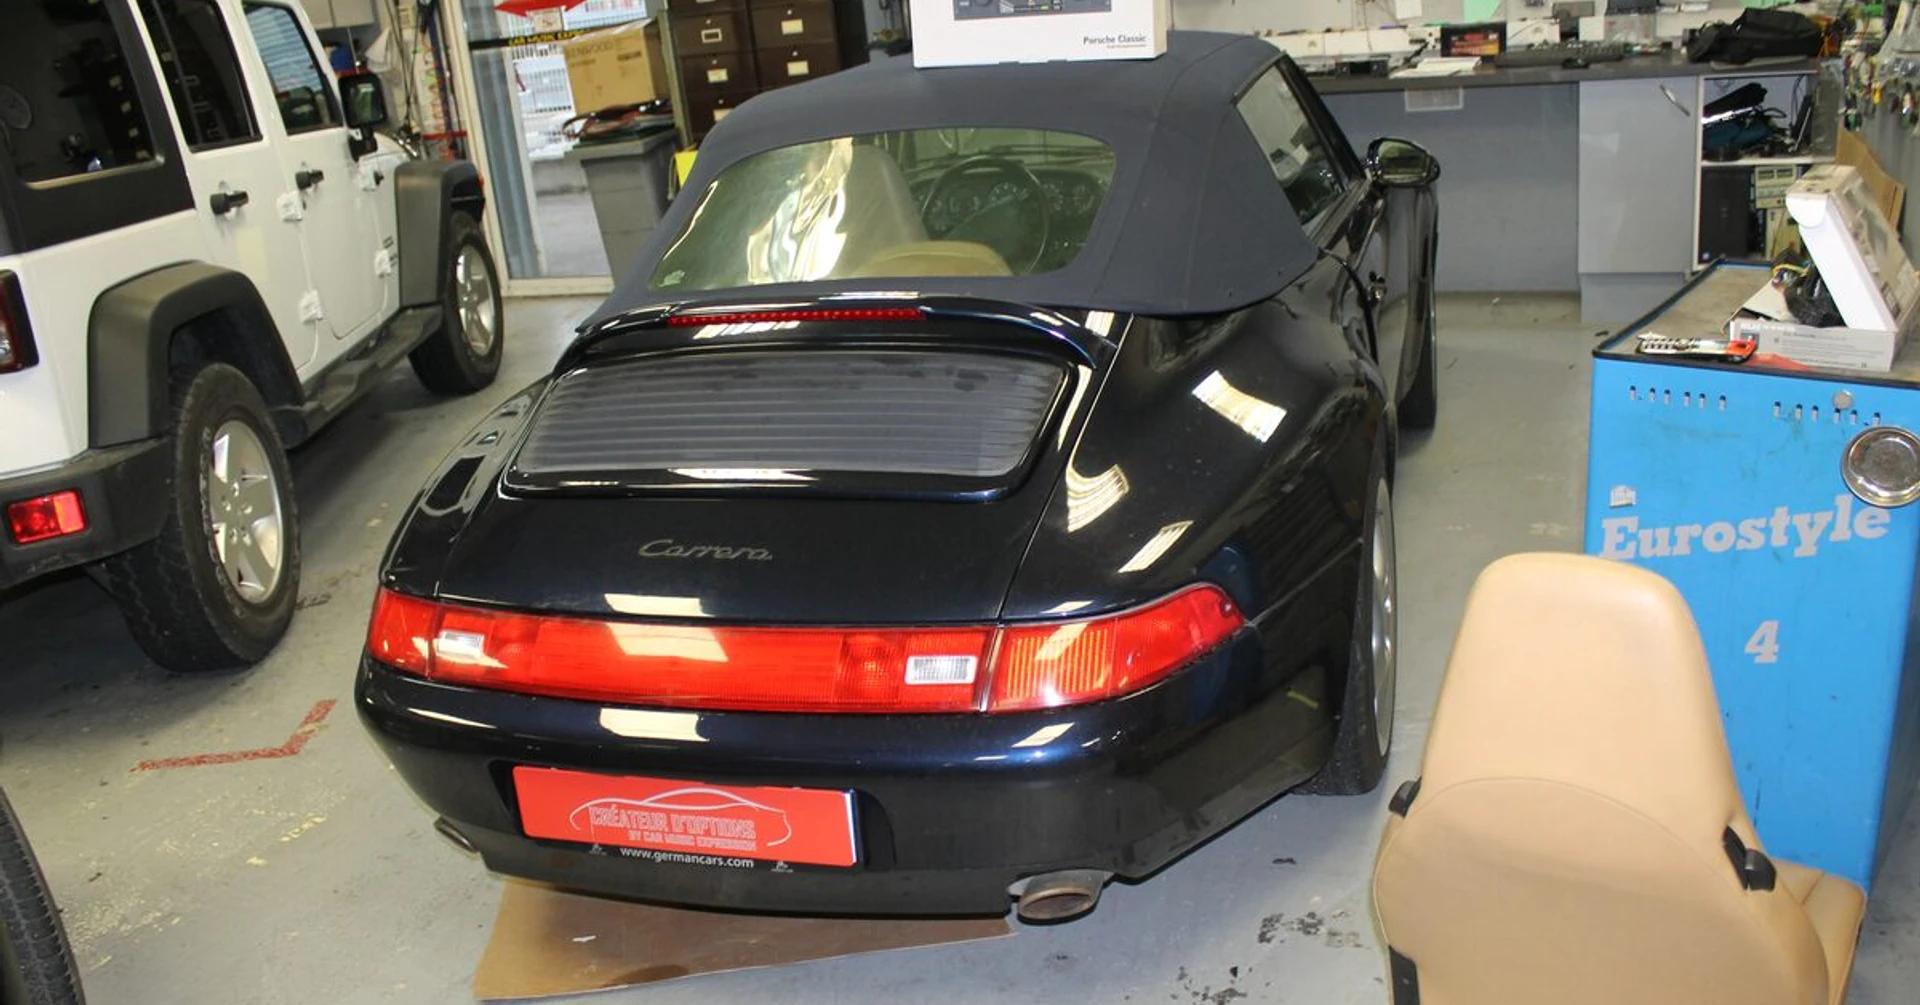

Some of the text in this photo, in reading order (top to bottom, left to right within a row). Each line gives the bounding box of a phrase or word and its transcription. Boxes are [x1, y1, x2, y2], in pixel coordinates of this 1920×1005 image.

[1083, 34, 1147, 45] Porsche Classic
[1599, 494, 1891, 561] Eurostyle
[638, 538, 773, 561] Carrera
[1744, 620, 1780, 664] 4
[590, 804, 757, 839] CRÉATEUR D'OPTIONS
[628, 830, 642, 841] BY
[643, 832, 664, 844] CAR
[664, 833, 695, 846] MUSIC
[619, 847, 754, 869] www.germancars.com
